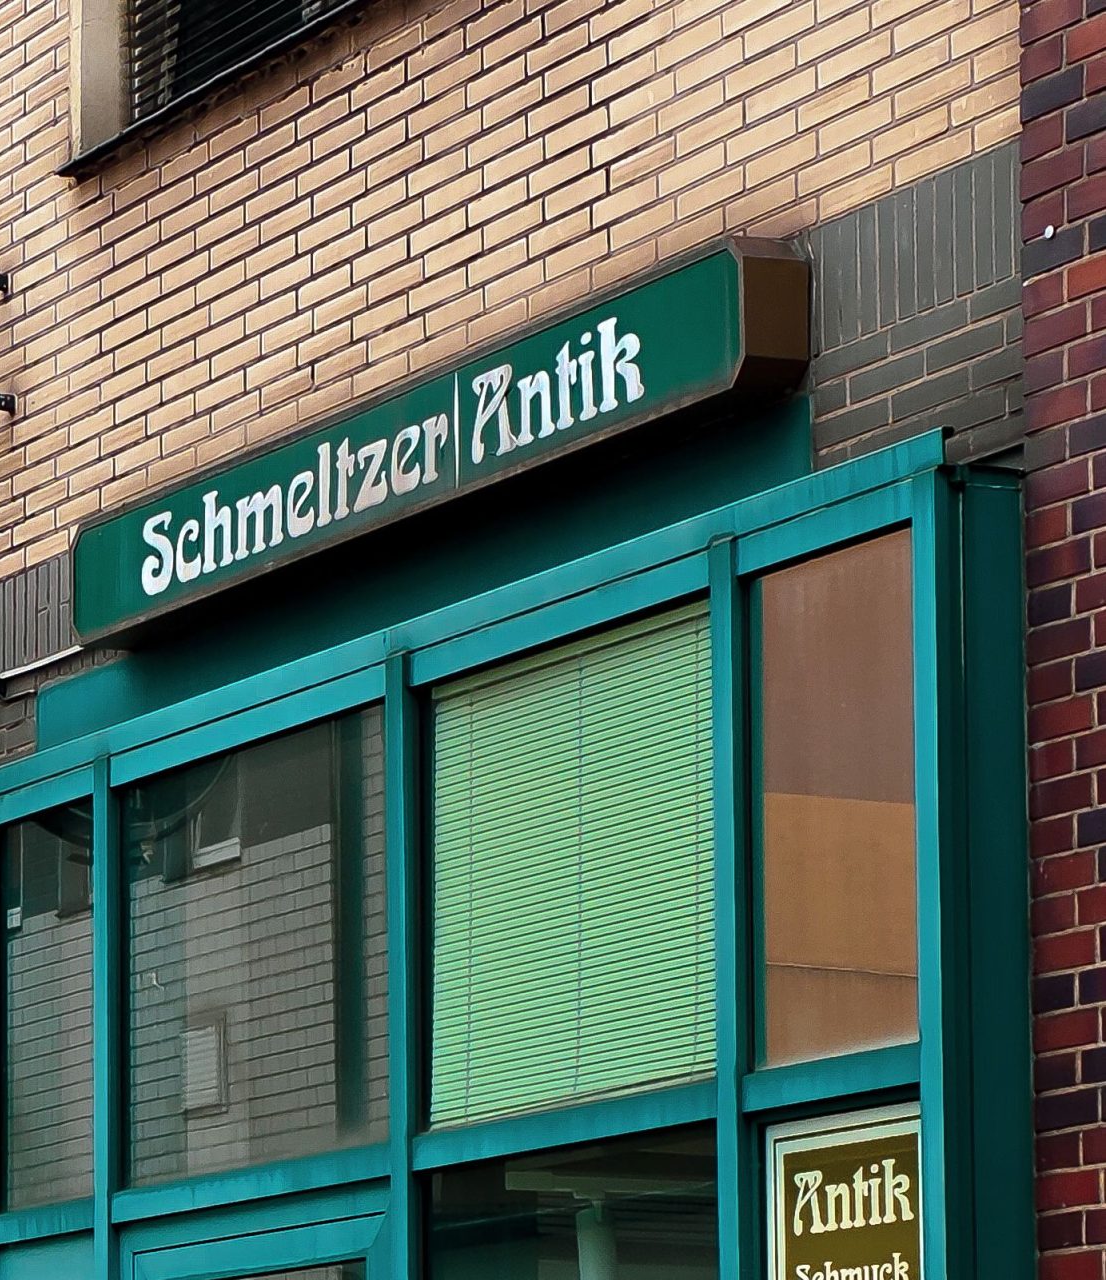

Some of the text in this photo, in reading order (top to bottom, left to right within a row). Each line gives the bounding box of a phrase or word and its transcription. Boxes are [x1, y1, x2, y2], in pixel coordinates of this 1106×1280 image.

[141, 317, 644, 596] Schmeltzer Antik
[793, 1158, 915, 1236] Antik
